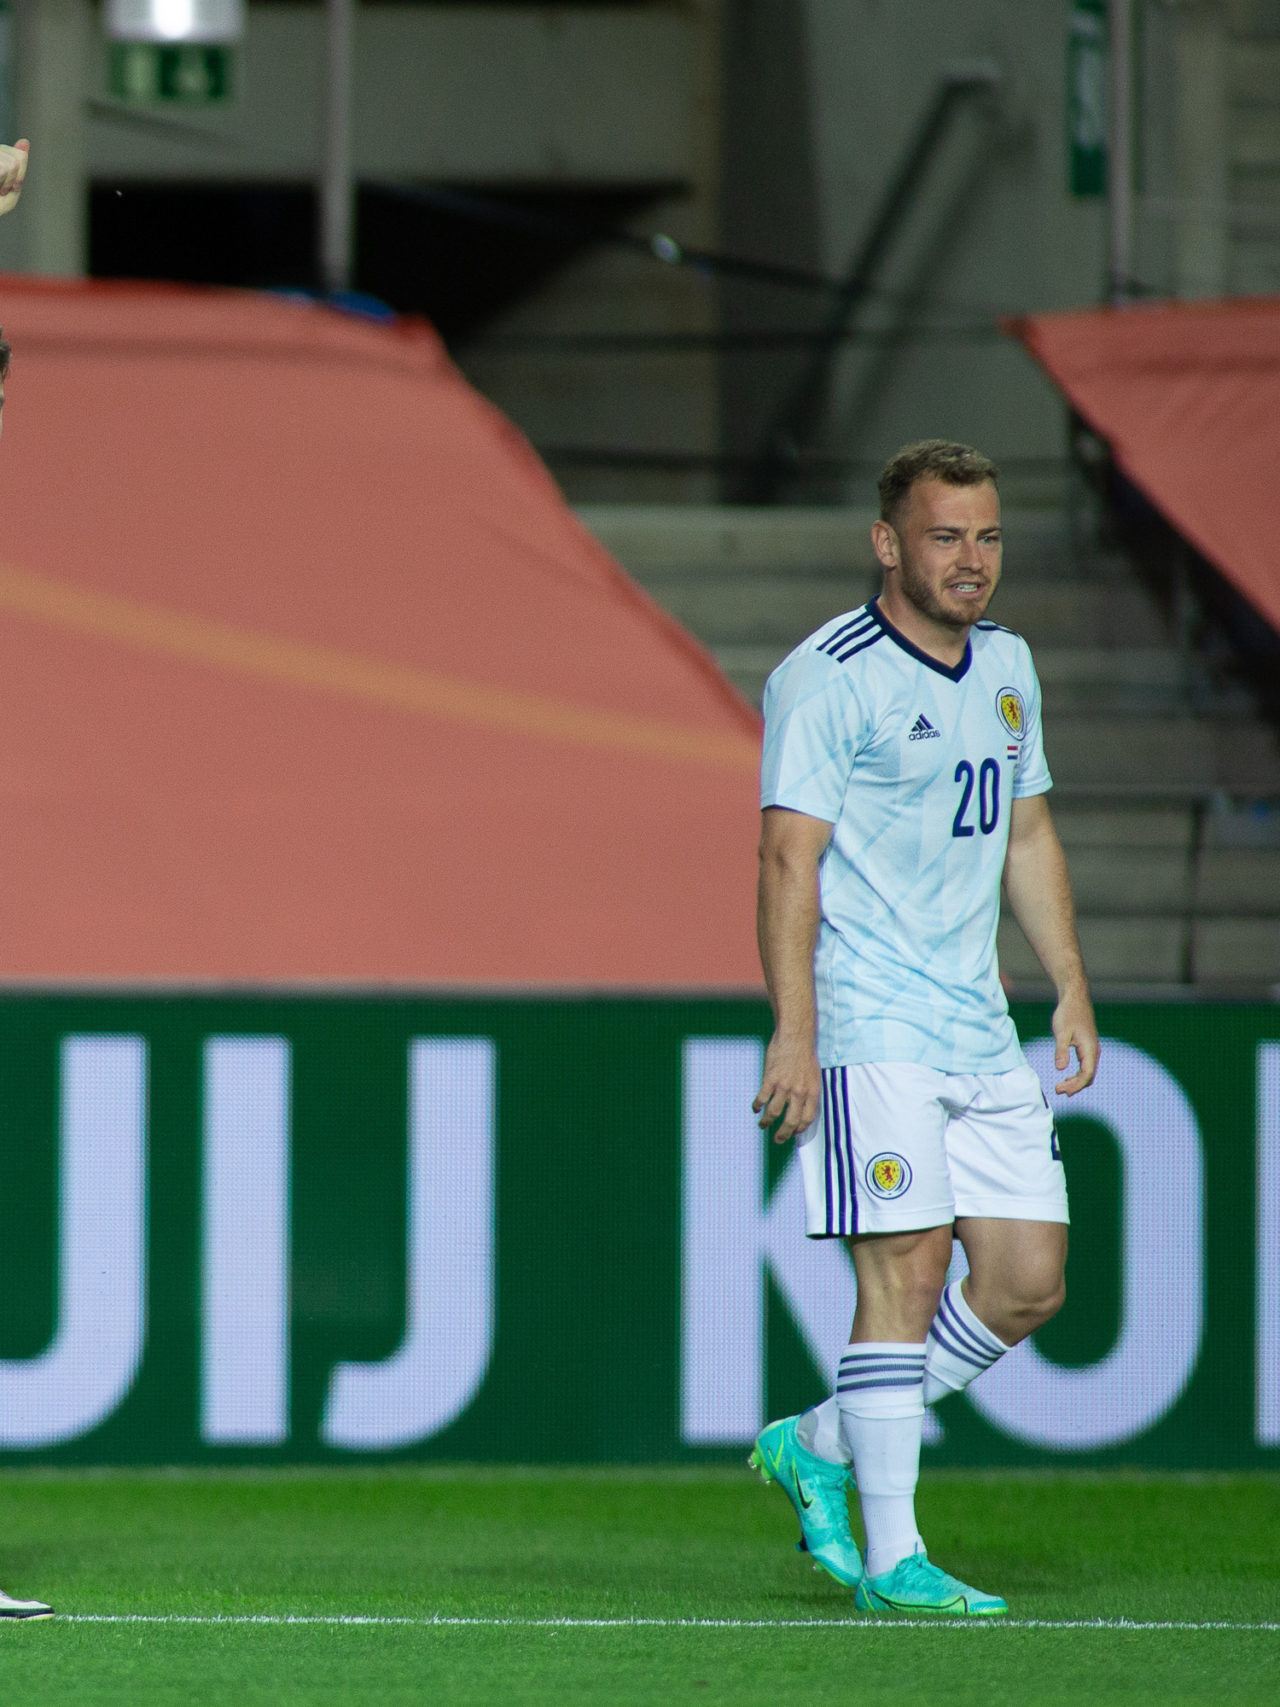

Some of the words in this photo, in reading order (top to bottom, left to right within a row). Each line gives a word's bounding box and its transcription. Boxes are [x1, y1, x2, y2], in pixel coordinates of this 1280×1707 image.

[908, 729, 941, 742] adidas
[952, 757, 1001, 838] 20
[679, 1035, 1280, 1453] KO
